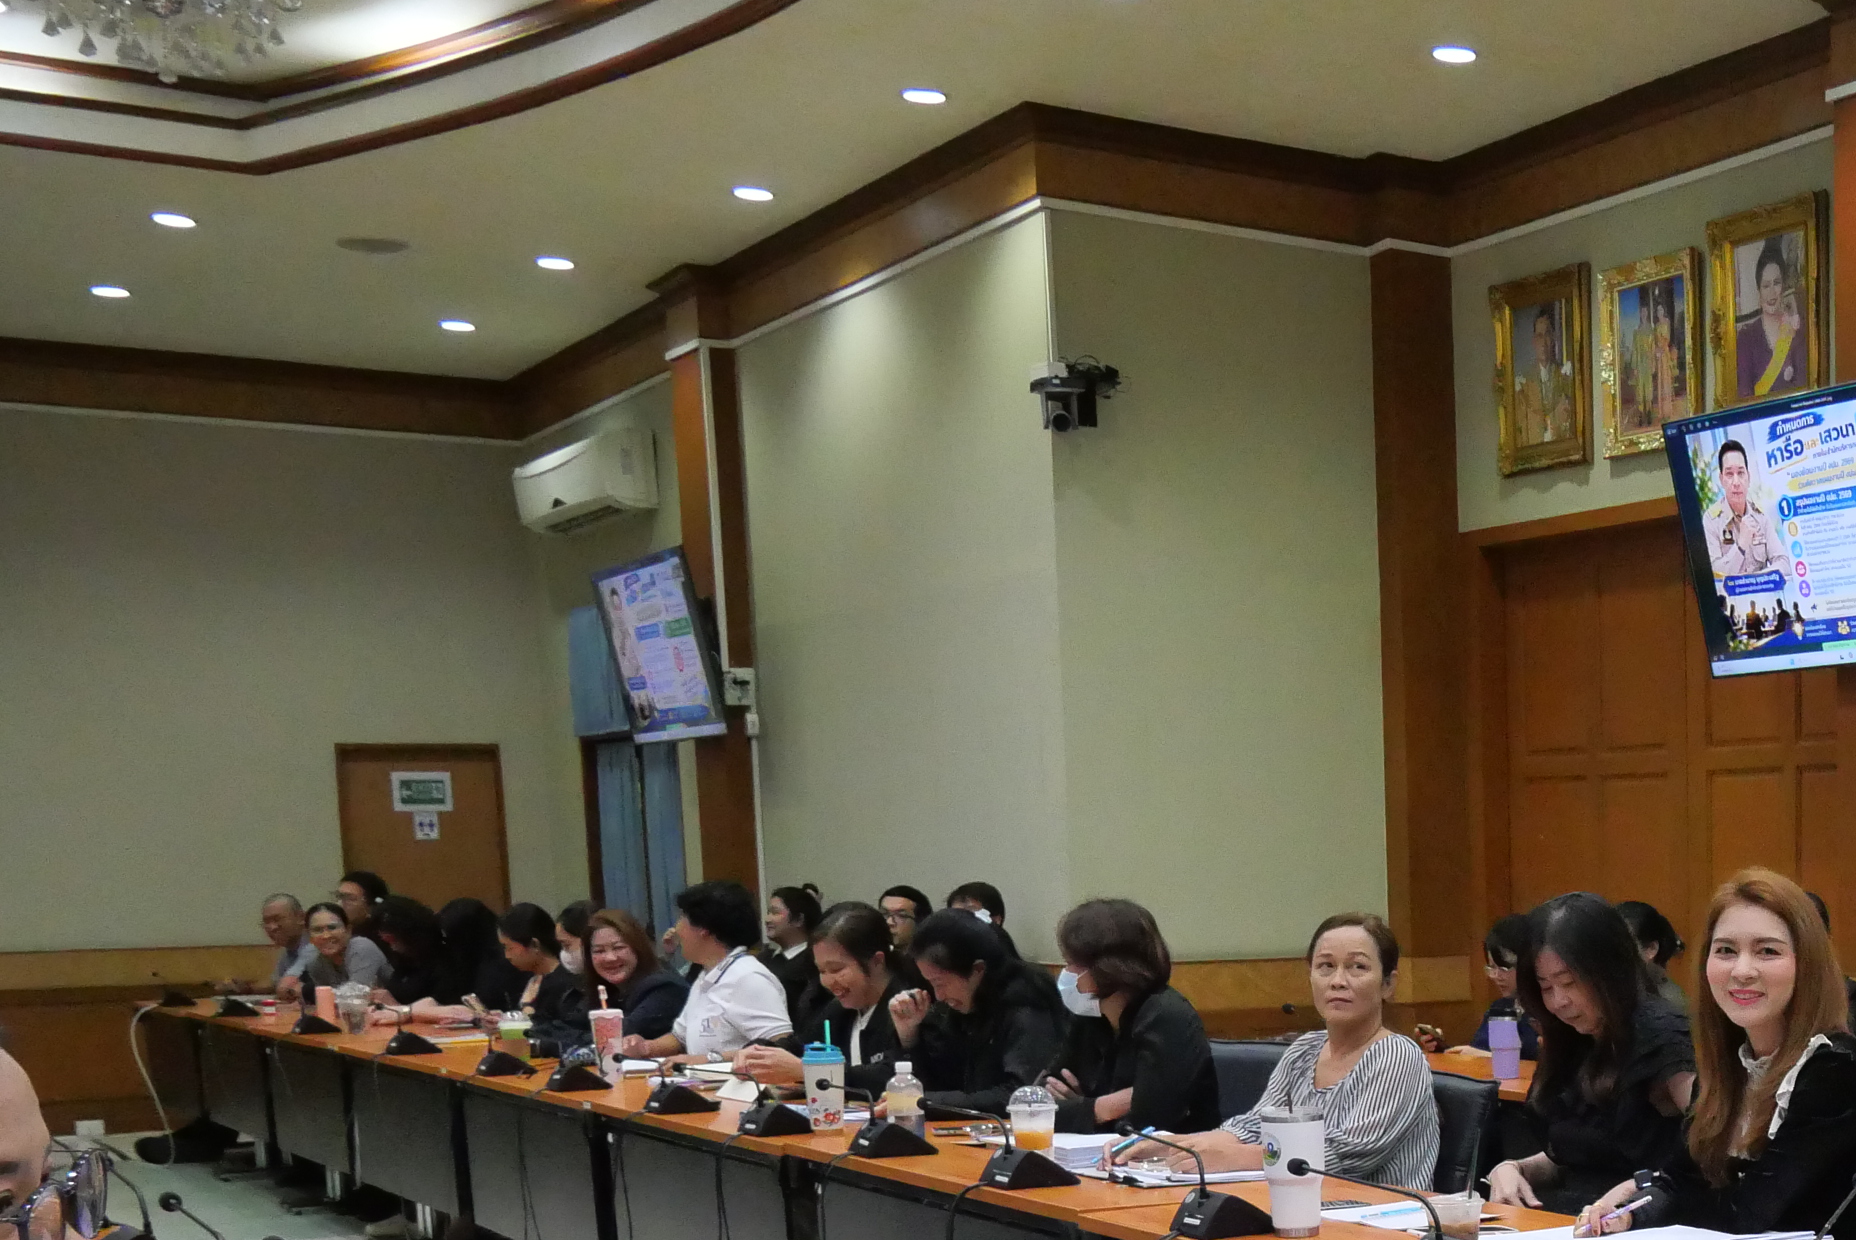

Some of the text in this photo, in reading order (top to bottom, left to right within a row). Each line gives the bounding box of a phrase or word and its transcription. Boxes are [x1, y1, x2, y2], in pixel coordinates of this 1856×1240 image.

[1775, 414, 1814, 436] กำหนดการ
[1780, 500, 1789, 515] 1
